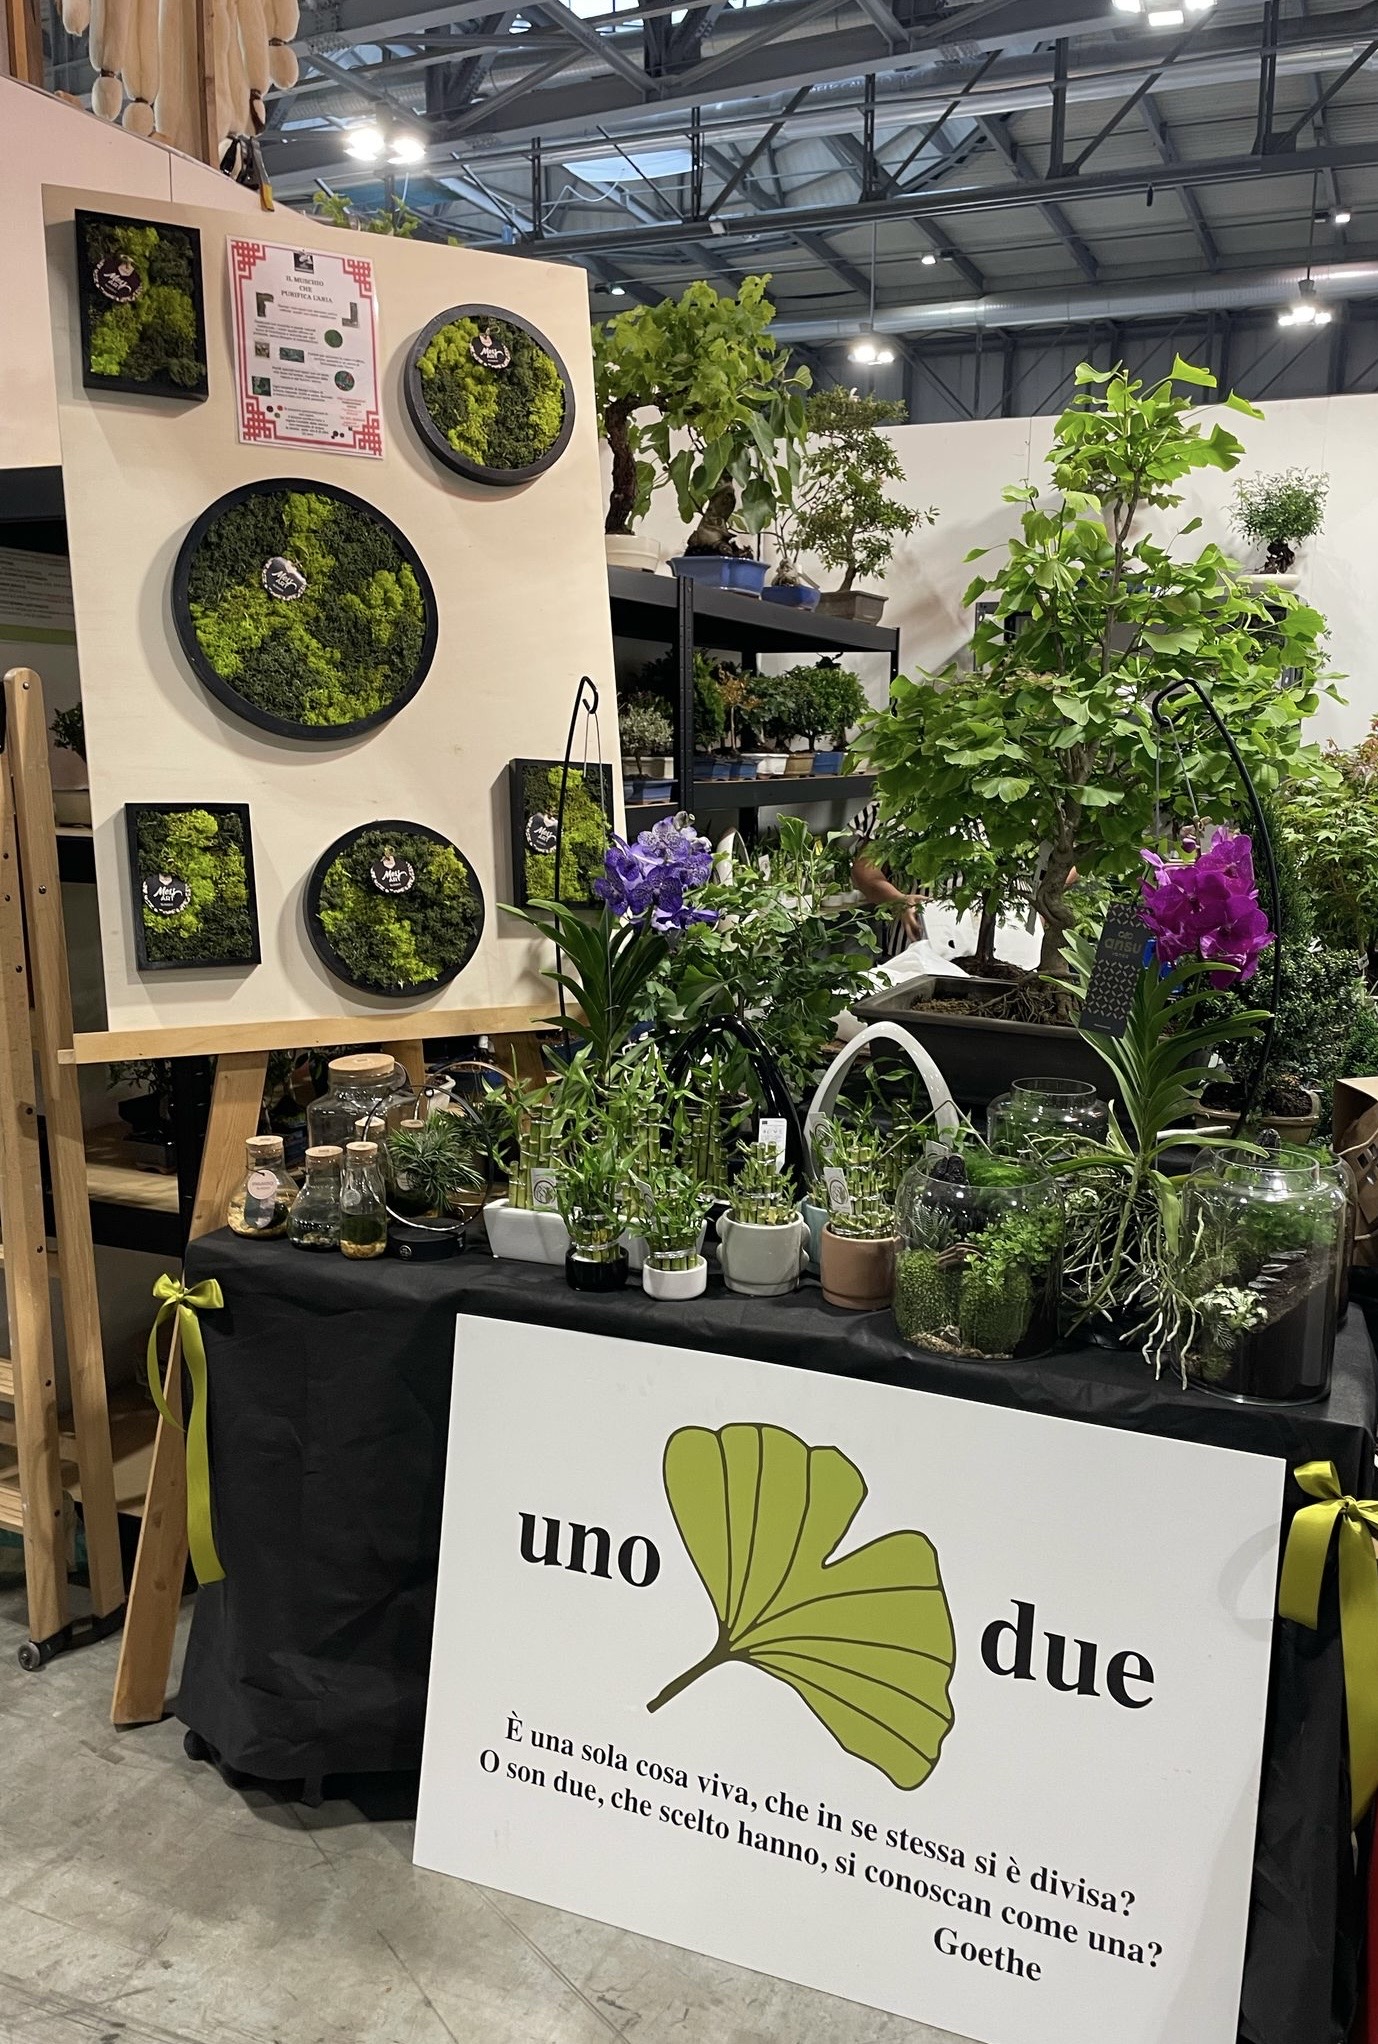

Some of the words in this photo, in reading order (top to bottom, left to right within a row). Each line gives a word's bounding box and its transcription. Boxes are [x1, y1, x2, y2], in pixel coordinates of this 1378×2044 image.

[281, 290, 311, 300] PURIFICA
[519, 1511, 660, 1588] uno
[981, 1598, 1155, 1709] due
[479, 1749, 500, 1773] O
[506, 1762, 546, 1788] son
[553, 1770, 604, 1809] due,
[611, 1787, 652, 1817] che
[659, 1805, 730, 1839] scelto
[737, 1820, 828, 1873] hanno,
[835, 1852, 855, 1877] si
[864, 1865, 992, 1919] conoscan
[1001, 1906, 1078, 1943] come
[1088, 1930, 1163, 1968] una?
[505, 1710, 523, 1742] È
[531, 1730, 574, 1757] una
[581, 1743, 628, 1772] sola
[636, 1759, 688, 1789] cosa
[697, 1773, 758, 1812] viva,
[764, 1791, 809, 1822] che
[817, 1802, 842, 1832] in
[851, 1819, 878, 1842] se
[885, 1826, 965, 1868] stessa
[974, 1852, 996, 1878] si
[1006, 1855, 1021, 1884] è
[1030, 1865, 1136, 1917] divisa?
[934, 1926, 1042, 1982] Goethe
